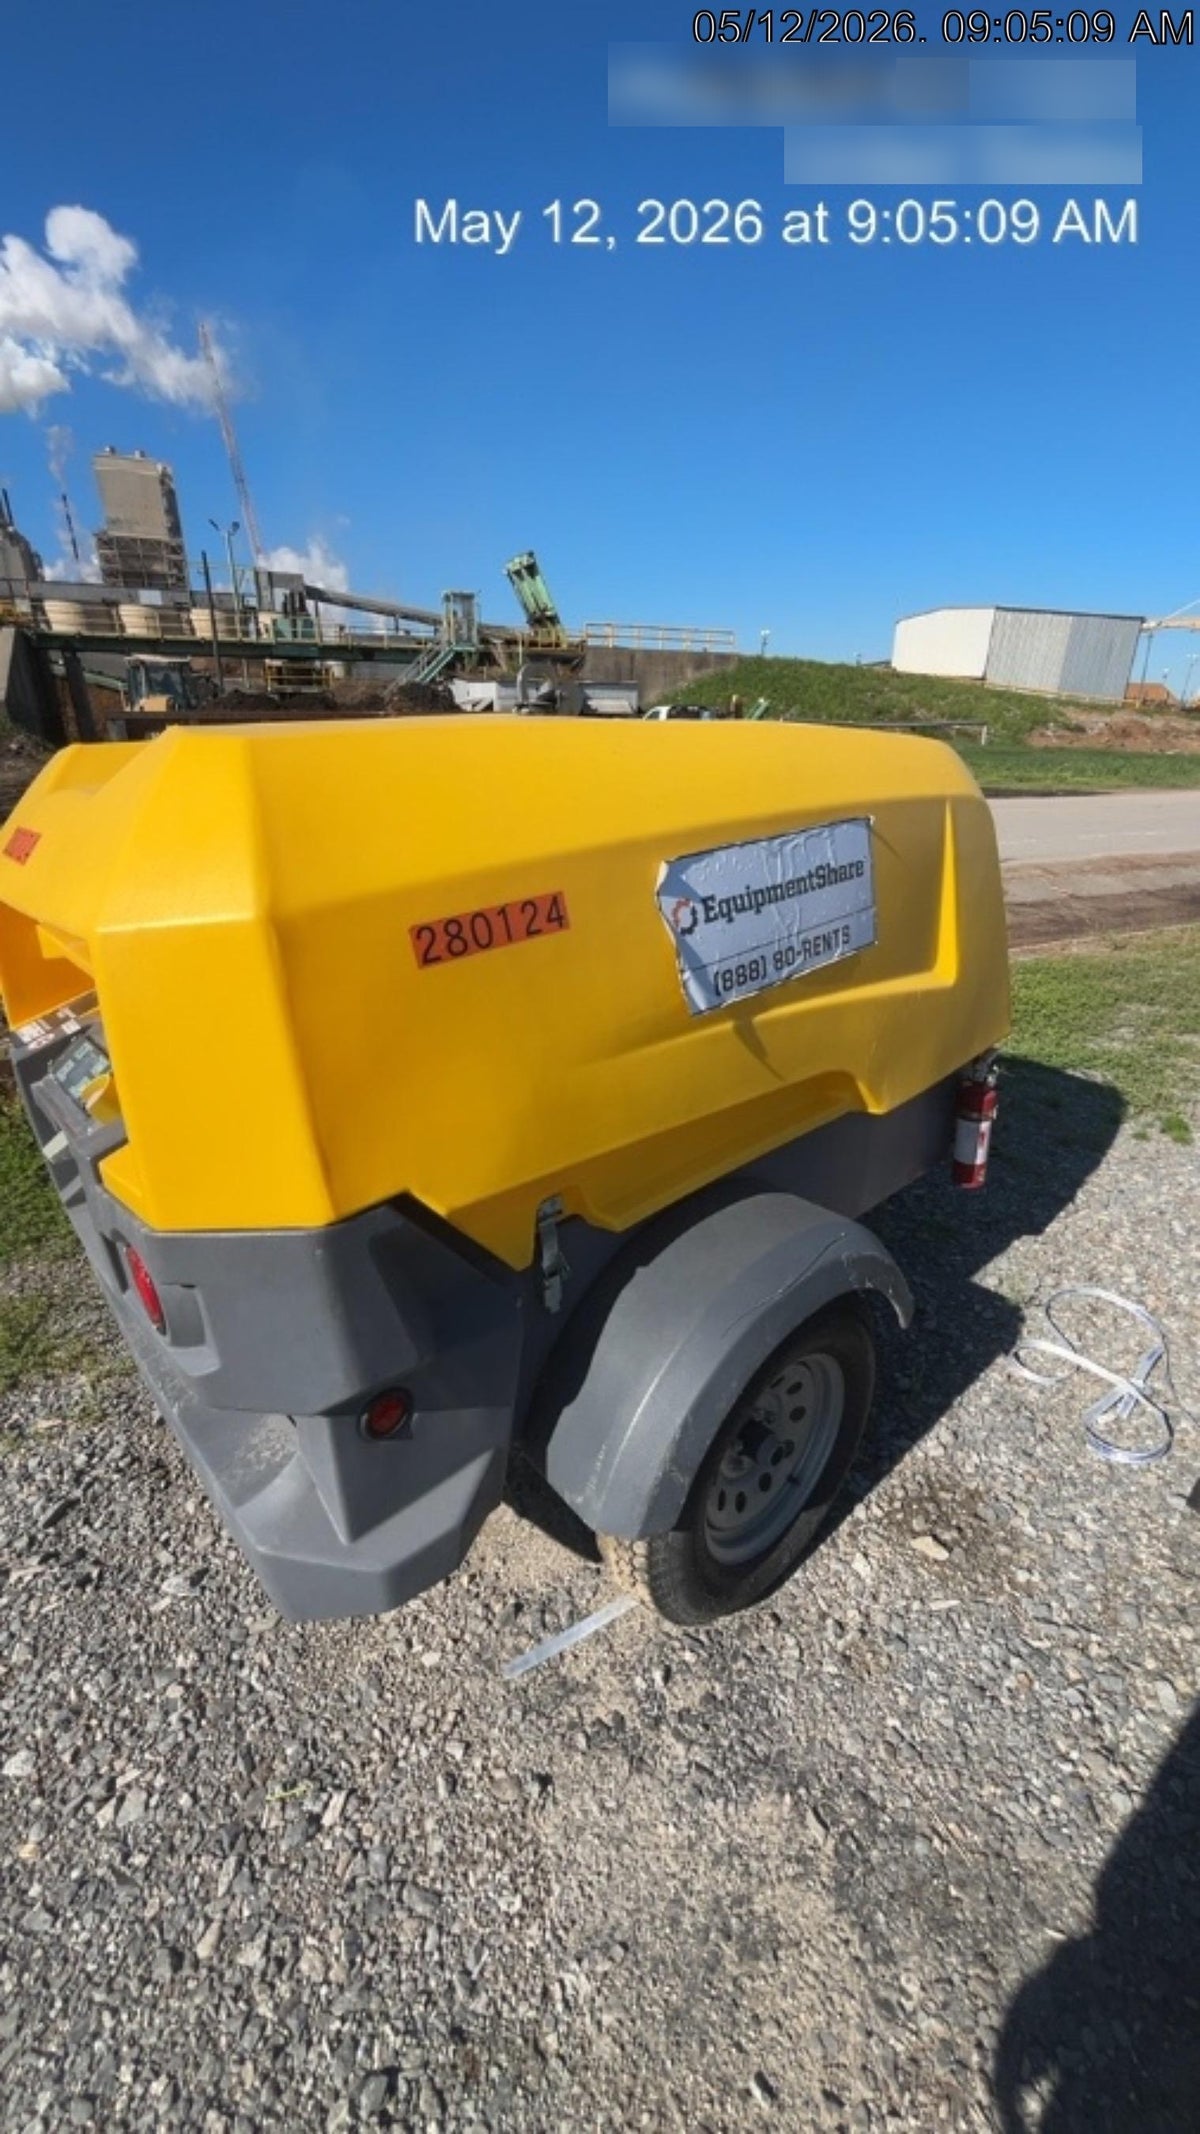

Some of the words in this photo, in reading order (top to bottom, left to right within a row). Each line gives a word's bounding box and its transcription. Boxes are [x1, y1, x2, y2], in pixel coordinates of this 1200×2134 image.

[702, 859, 864, 924] EquipmentShare
[416, 896, 564, 965] 280124
[714, 955, 767, 997] (888)
[772, 925, 850, 971] 80-RENTS
